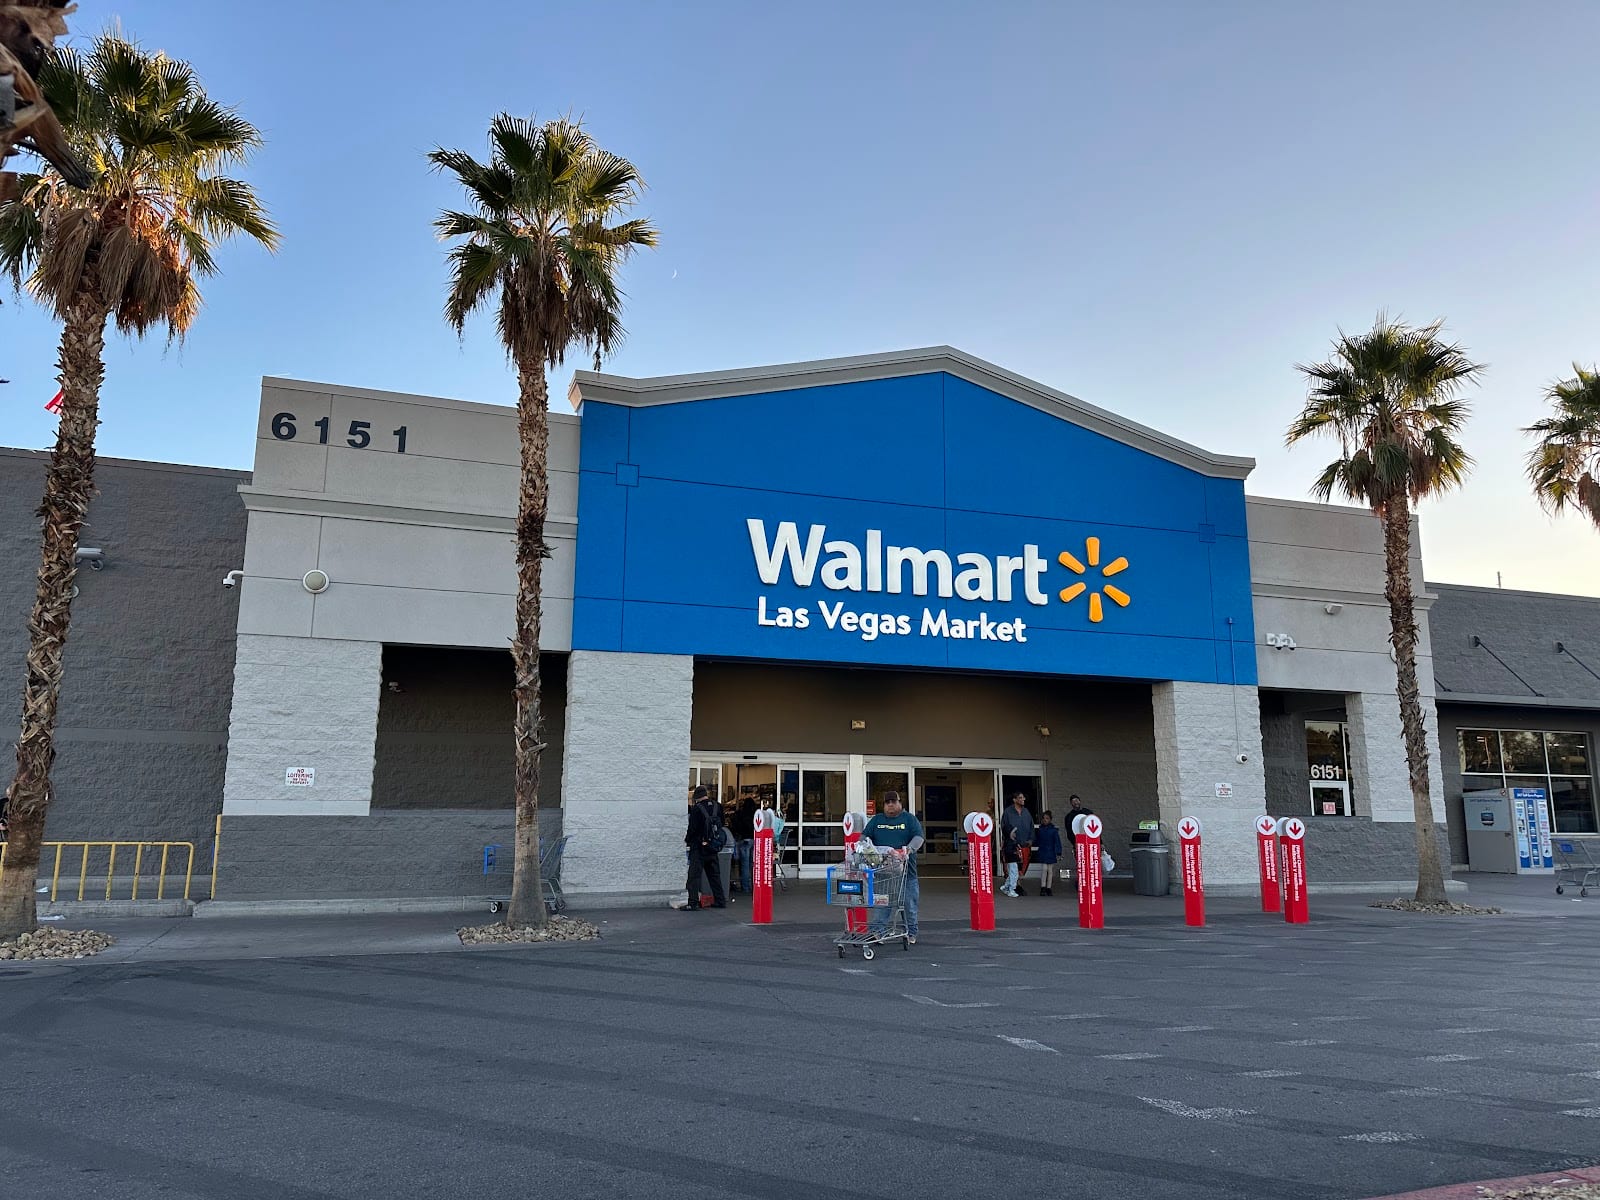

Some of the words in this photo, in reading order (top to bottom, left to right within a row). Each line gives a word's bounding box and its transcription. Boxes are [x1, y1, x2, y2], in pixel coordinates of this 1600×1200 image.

[271, 412, 407, 453] 6151
[746, 518, 1048, 606] Walmart
[758, 596, 810, 628] Las
[817, 600, 912, 641] Vegas
[920, 607, 1027, 642] Market
[1311, 764, 1339, 779] 6151
